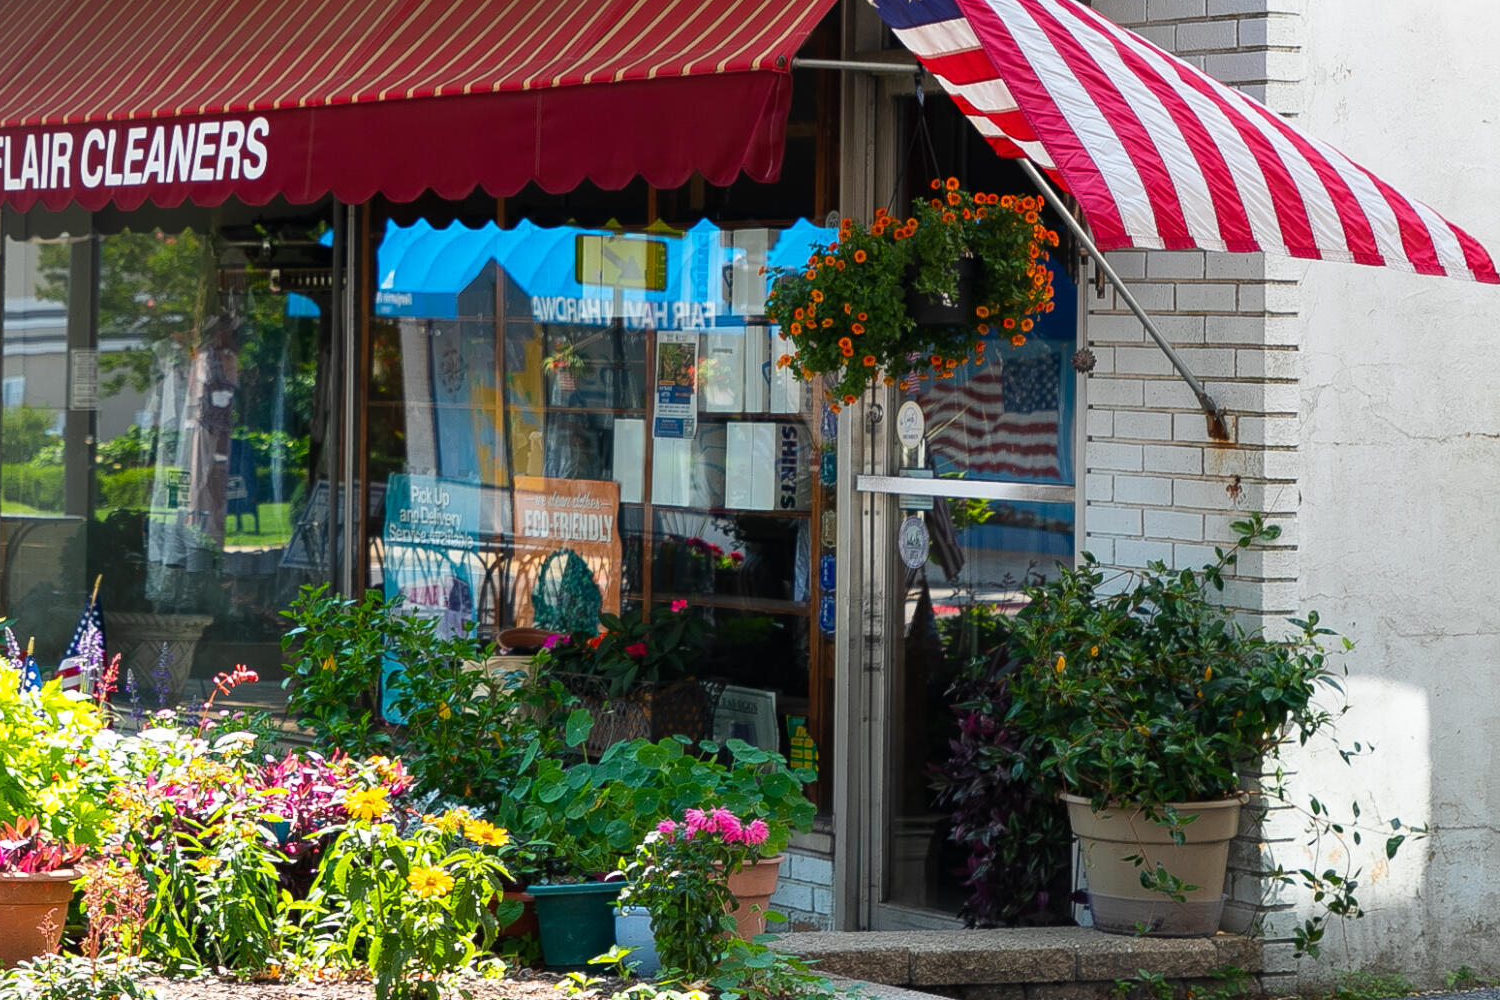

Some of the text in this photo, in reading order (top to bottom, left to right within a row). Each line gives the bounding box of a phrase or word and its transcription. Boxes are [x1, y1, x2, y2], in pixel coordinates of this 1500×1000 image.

[80, 116, 270, 189] CLEANERS
[780, 425, 798, 510] SHIRTS
[410, 485, 450, 507] Pick Up
[399, 505, 462, 530] and Delivery
[523, 510, 614, 543] ECO-FRIENDLY
[389, 523, 427, 544] Service
